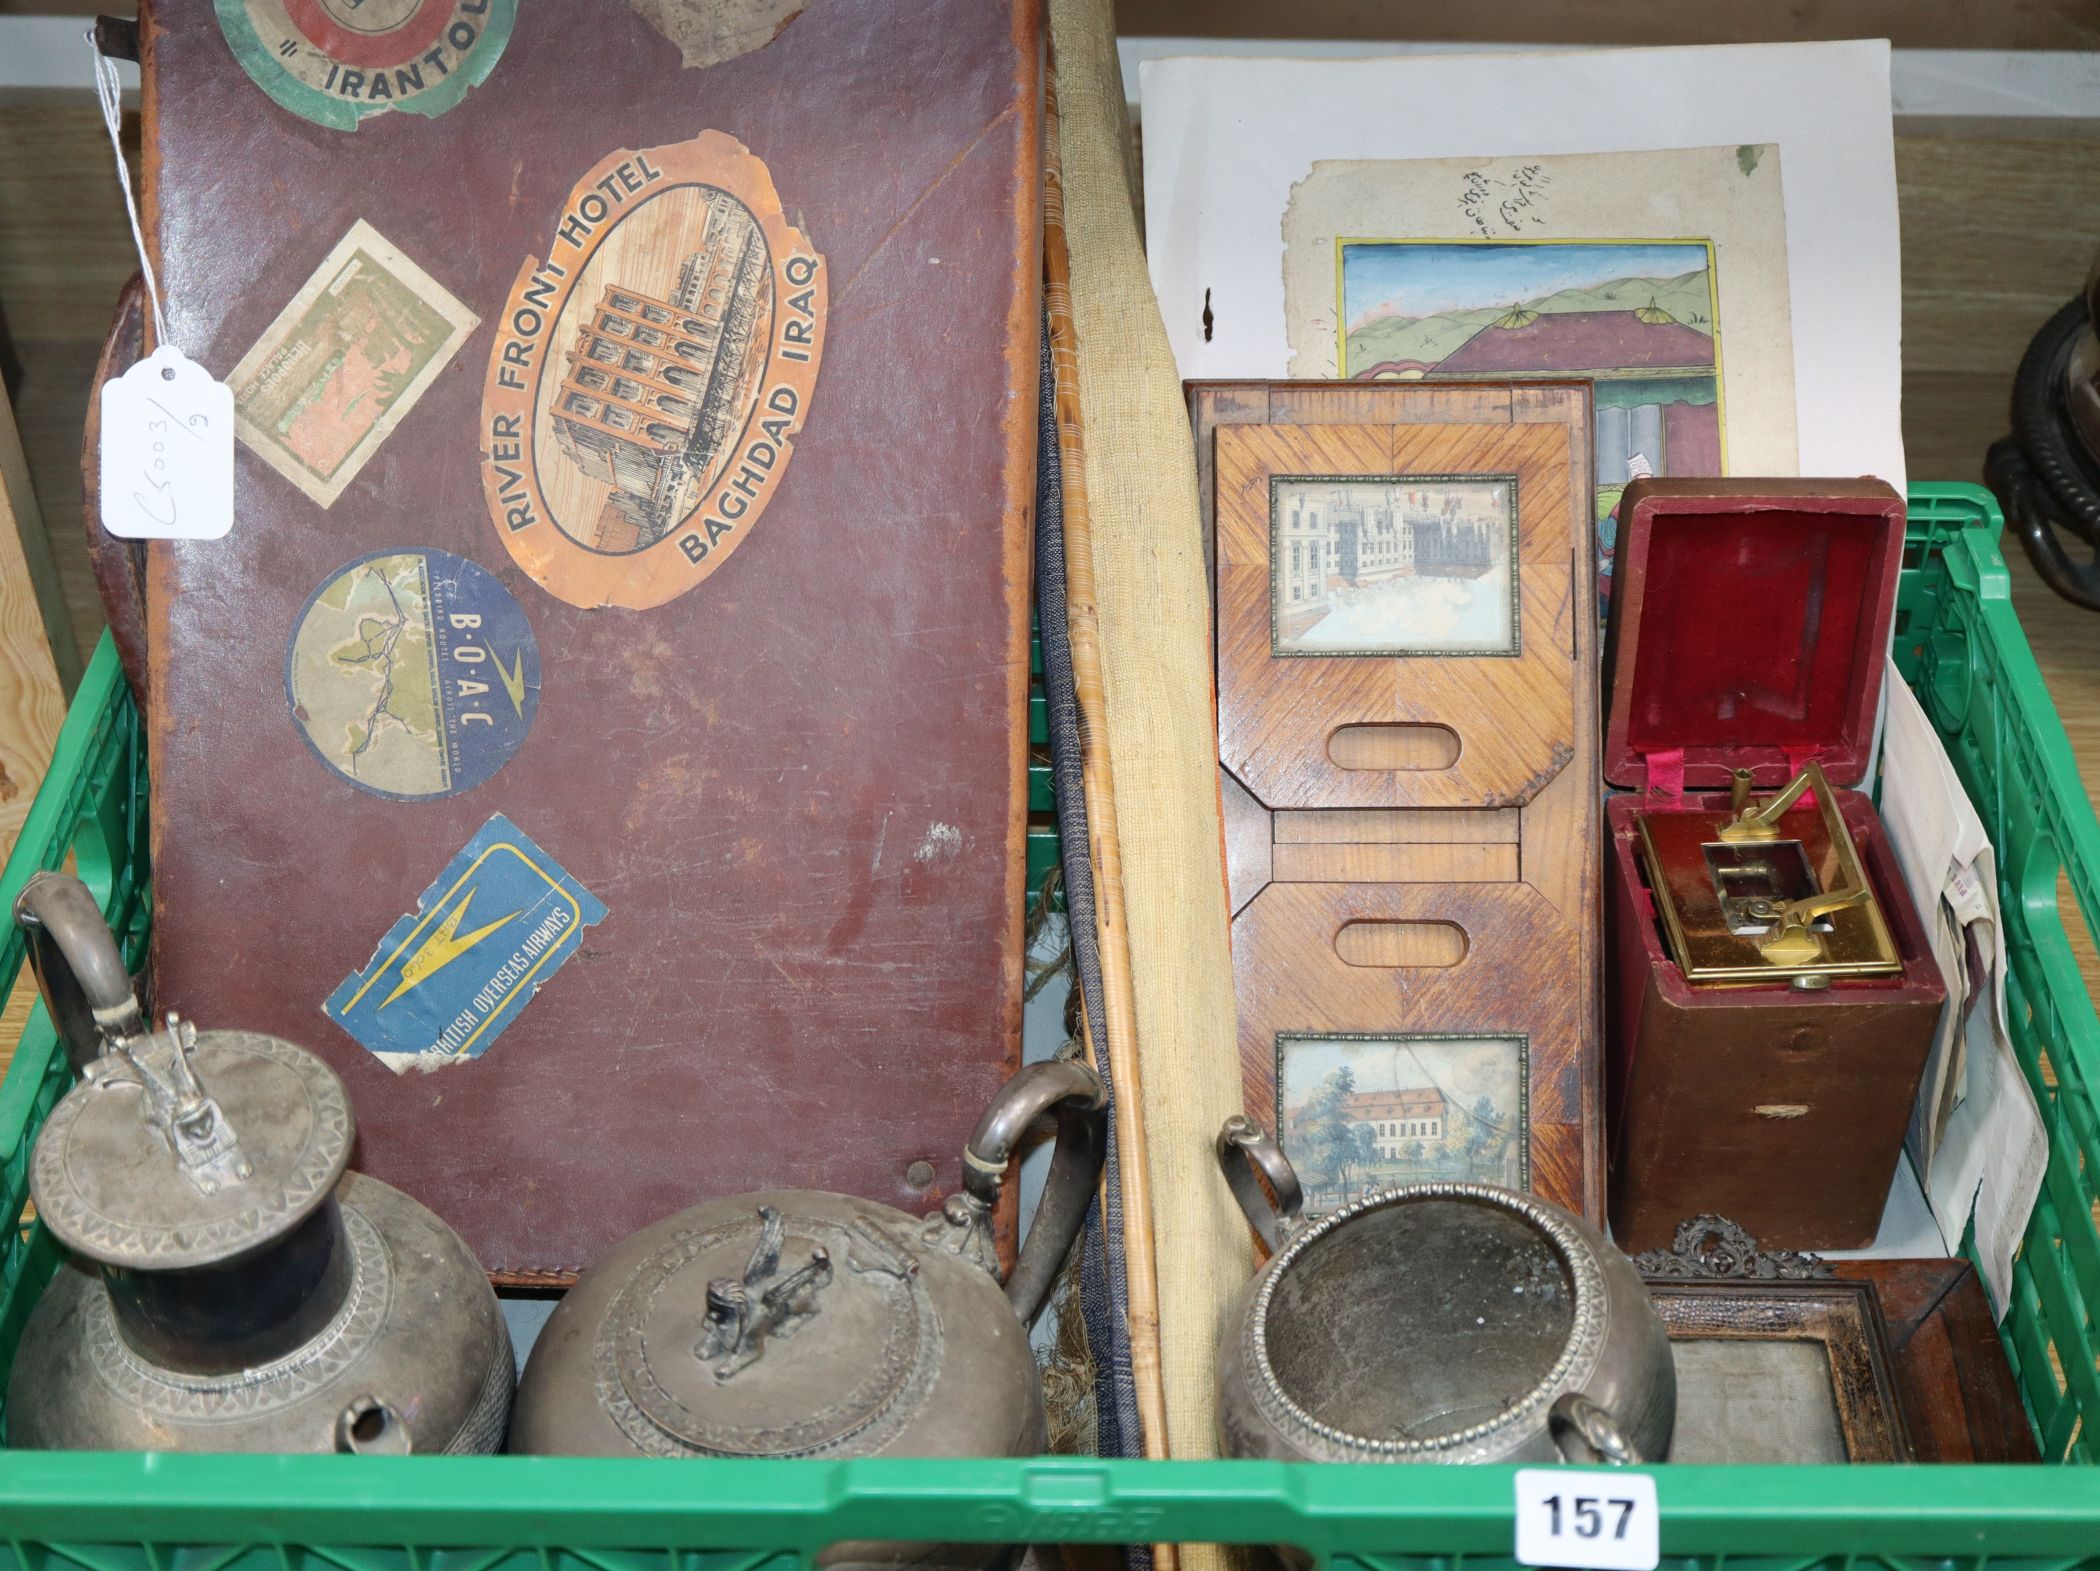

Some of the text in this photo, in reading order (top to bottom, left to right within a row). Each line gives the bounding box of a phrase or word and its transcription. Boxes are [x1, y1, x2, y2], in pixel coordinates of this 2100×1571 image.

[257, 347, 289, 381] PALACE
[494, 154, 662, 532] RIVER FRONT HOTEL
[678, 254, 820, 565] BAGHDAD IRAQ
[450, 741, 461, 773] WORLD
[472, 951, 529, 1014] OVERSEAS
[521, 906, 571, 960] AIRWAYS
[1541, 1494, 1636, 1540] 157
